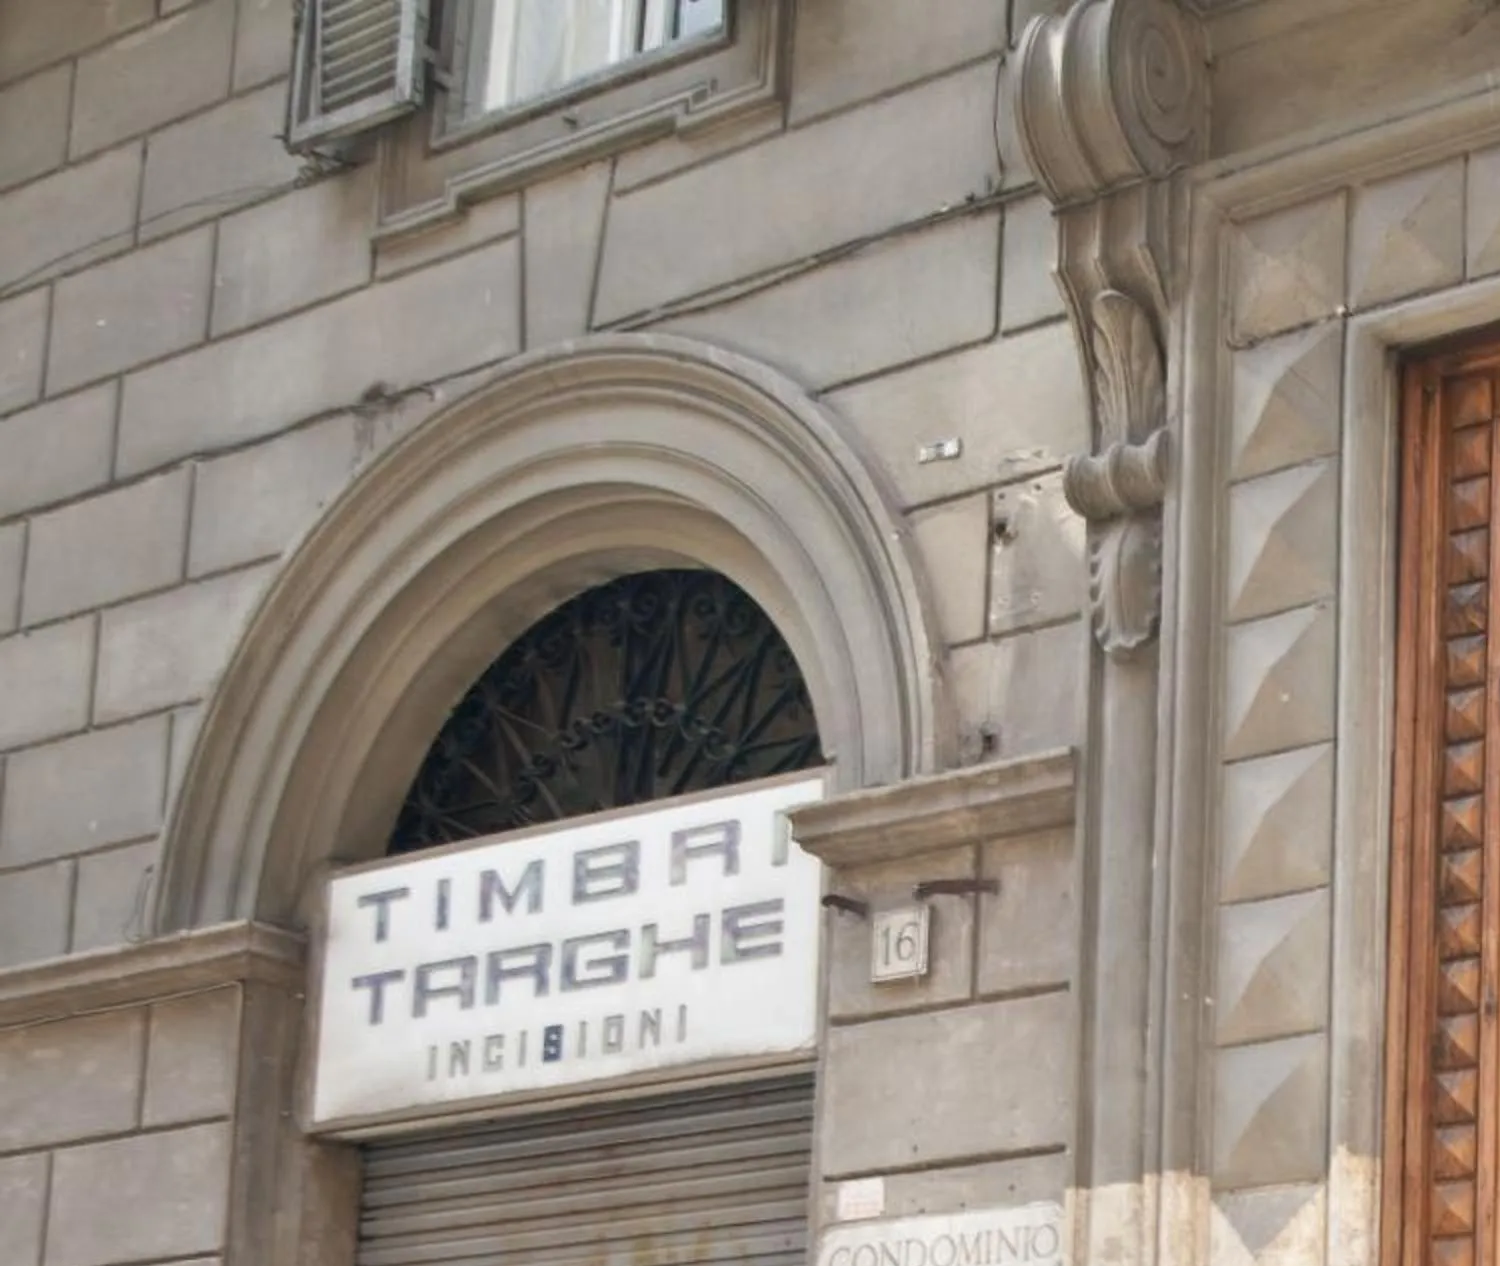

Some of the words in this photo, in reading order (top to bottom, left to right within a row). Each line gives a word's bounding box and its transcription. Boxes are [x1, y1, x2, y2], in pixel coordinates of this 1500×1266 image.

[356, 810, 791, 943] TIMBRI
[351, 898, 785, 1027] TARGHE
[881, 921, 920, 967] 16
[427, 1004, 688, 1082] INCISIONI
